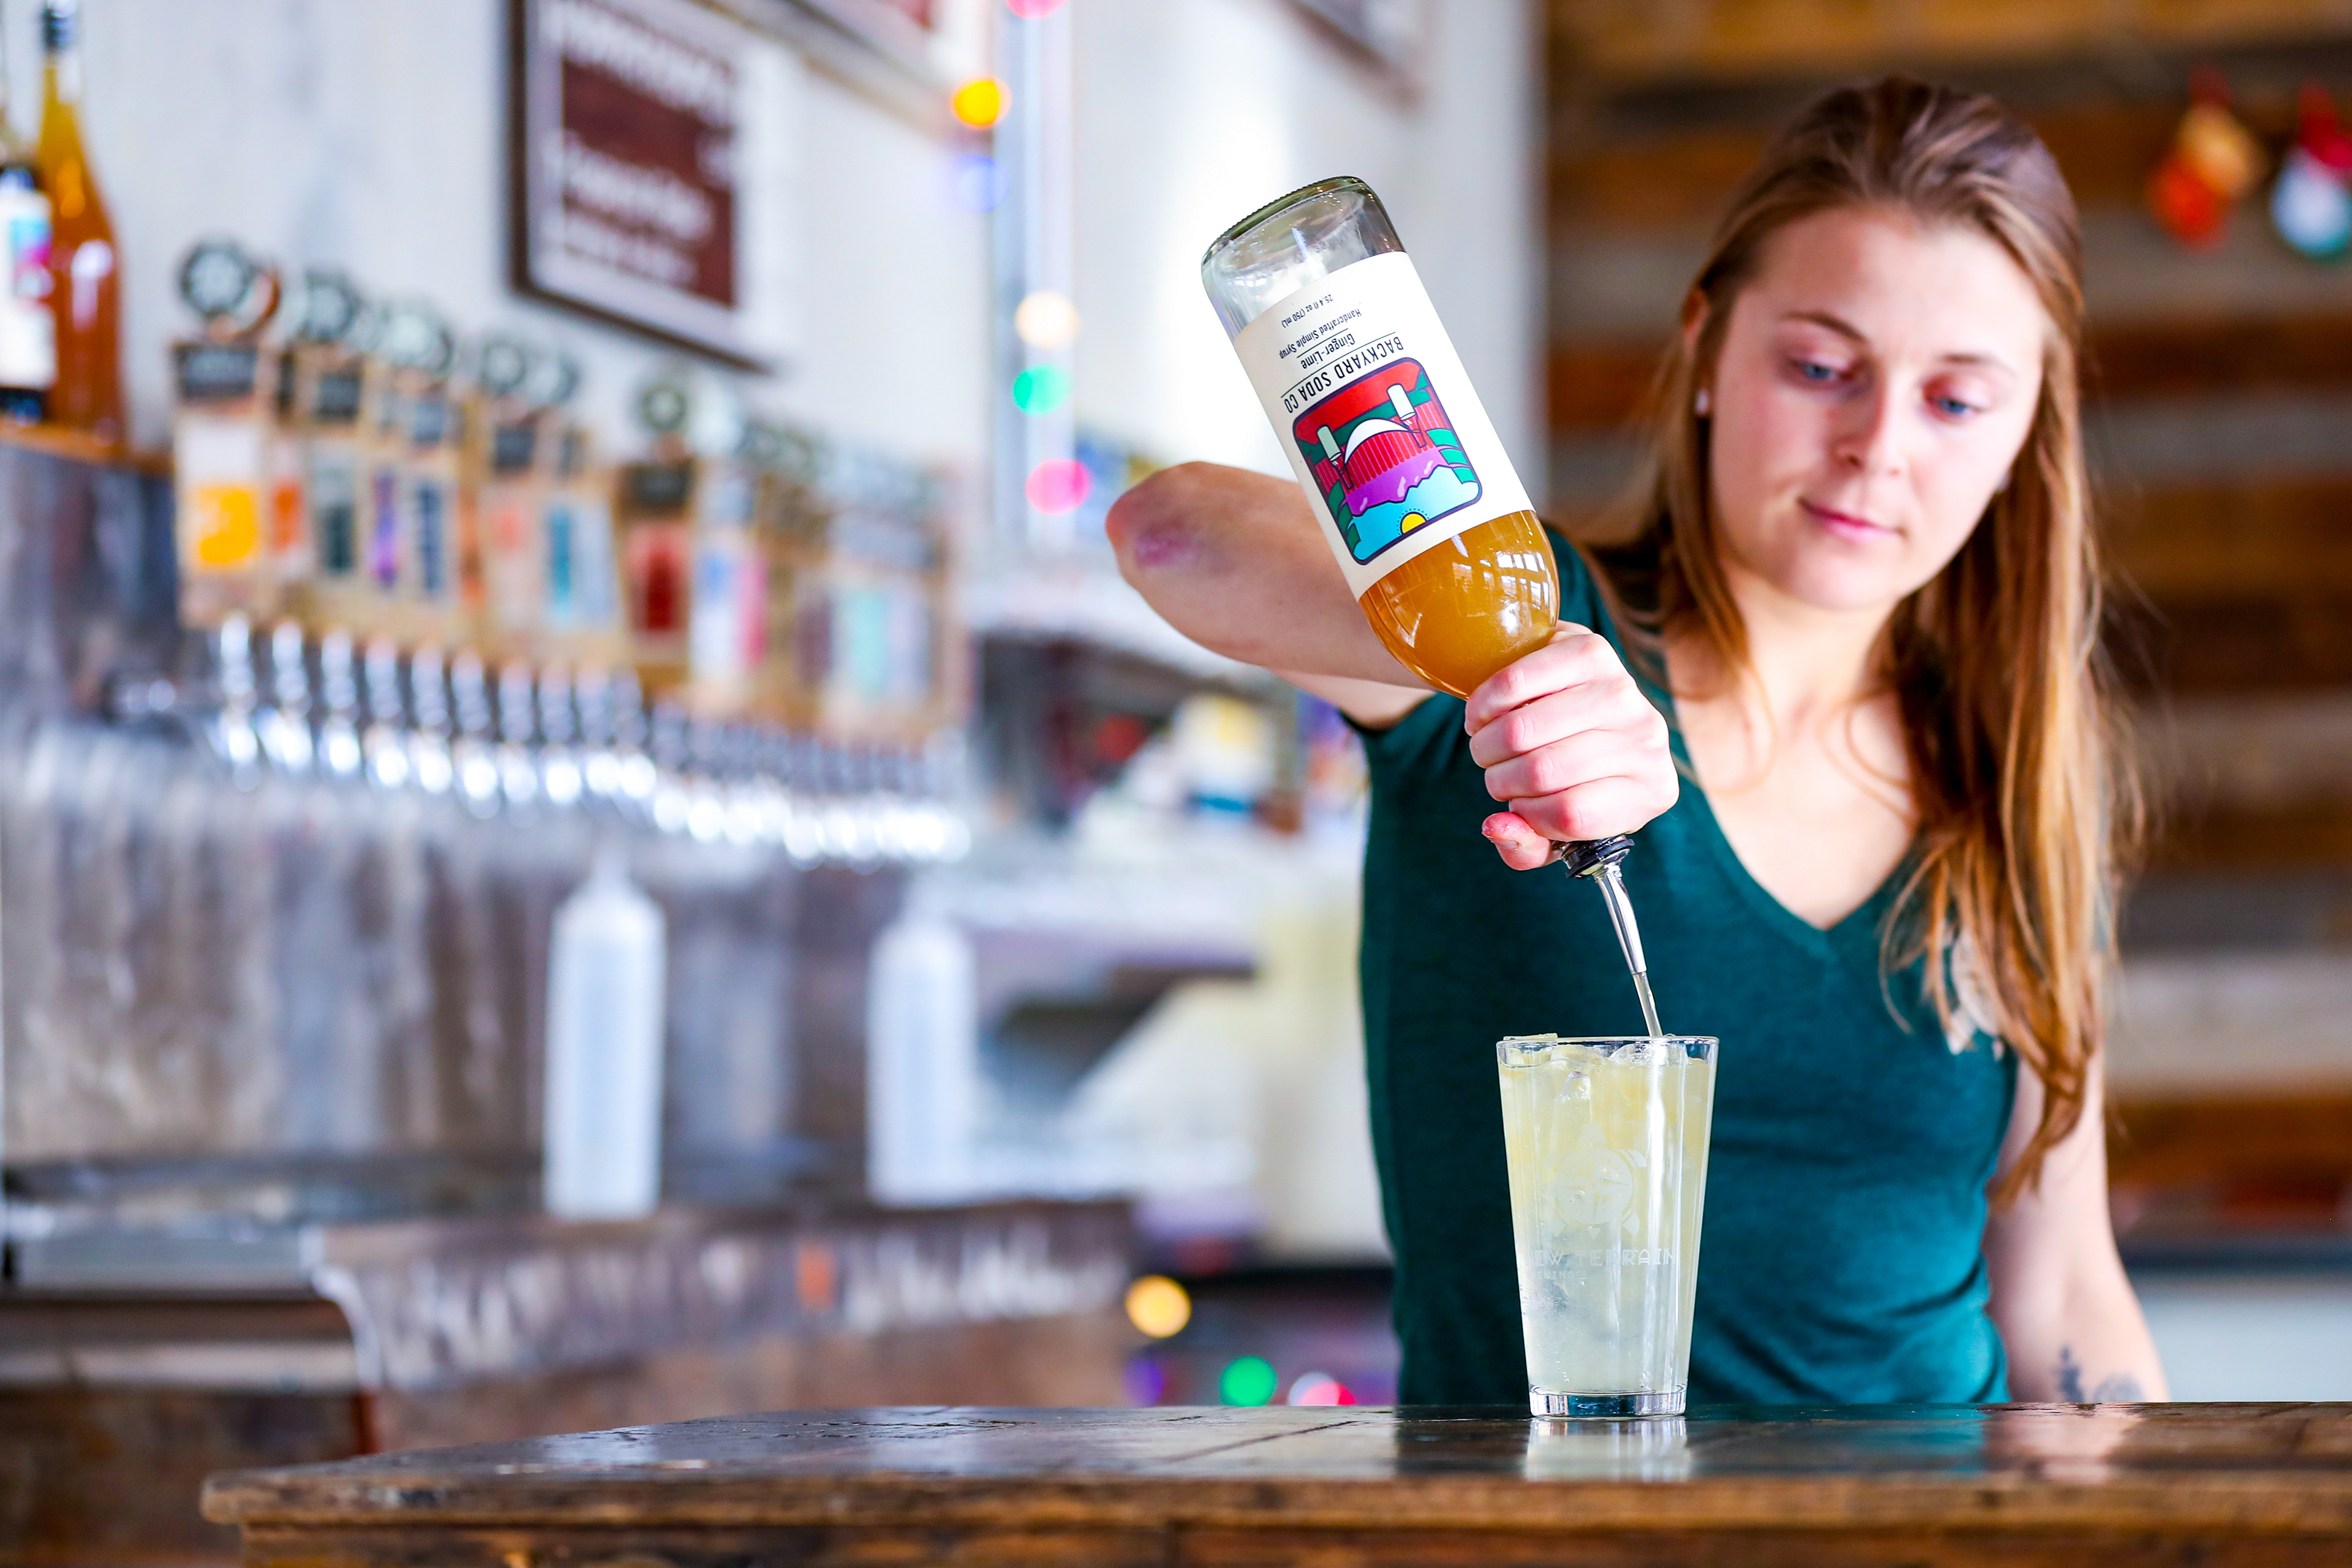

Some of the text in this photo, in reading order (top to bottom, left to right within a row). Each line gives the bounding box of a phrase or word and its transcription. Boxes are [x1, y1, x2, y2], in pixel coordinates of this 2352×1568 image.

[1319, 294, 1333, 306] 25.4
[1281, 317, 1292, 328] mL)
[1292, 308, 1306, 322] (750
[1279, 309, 1362, 359] Handcrafted Simple Syrup
[1301, 334, 1355, 369] Ginger-Lime
[1284, 337, 1404, 413] BACKYARD SODA CO
[1575, 1248, 1676, 1267] TERRAIN
